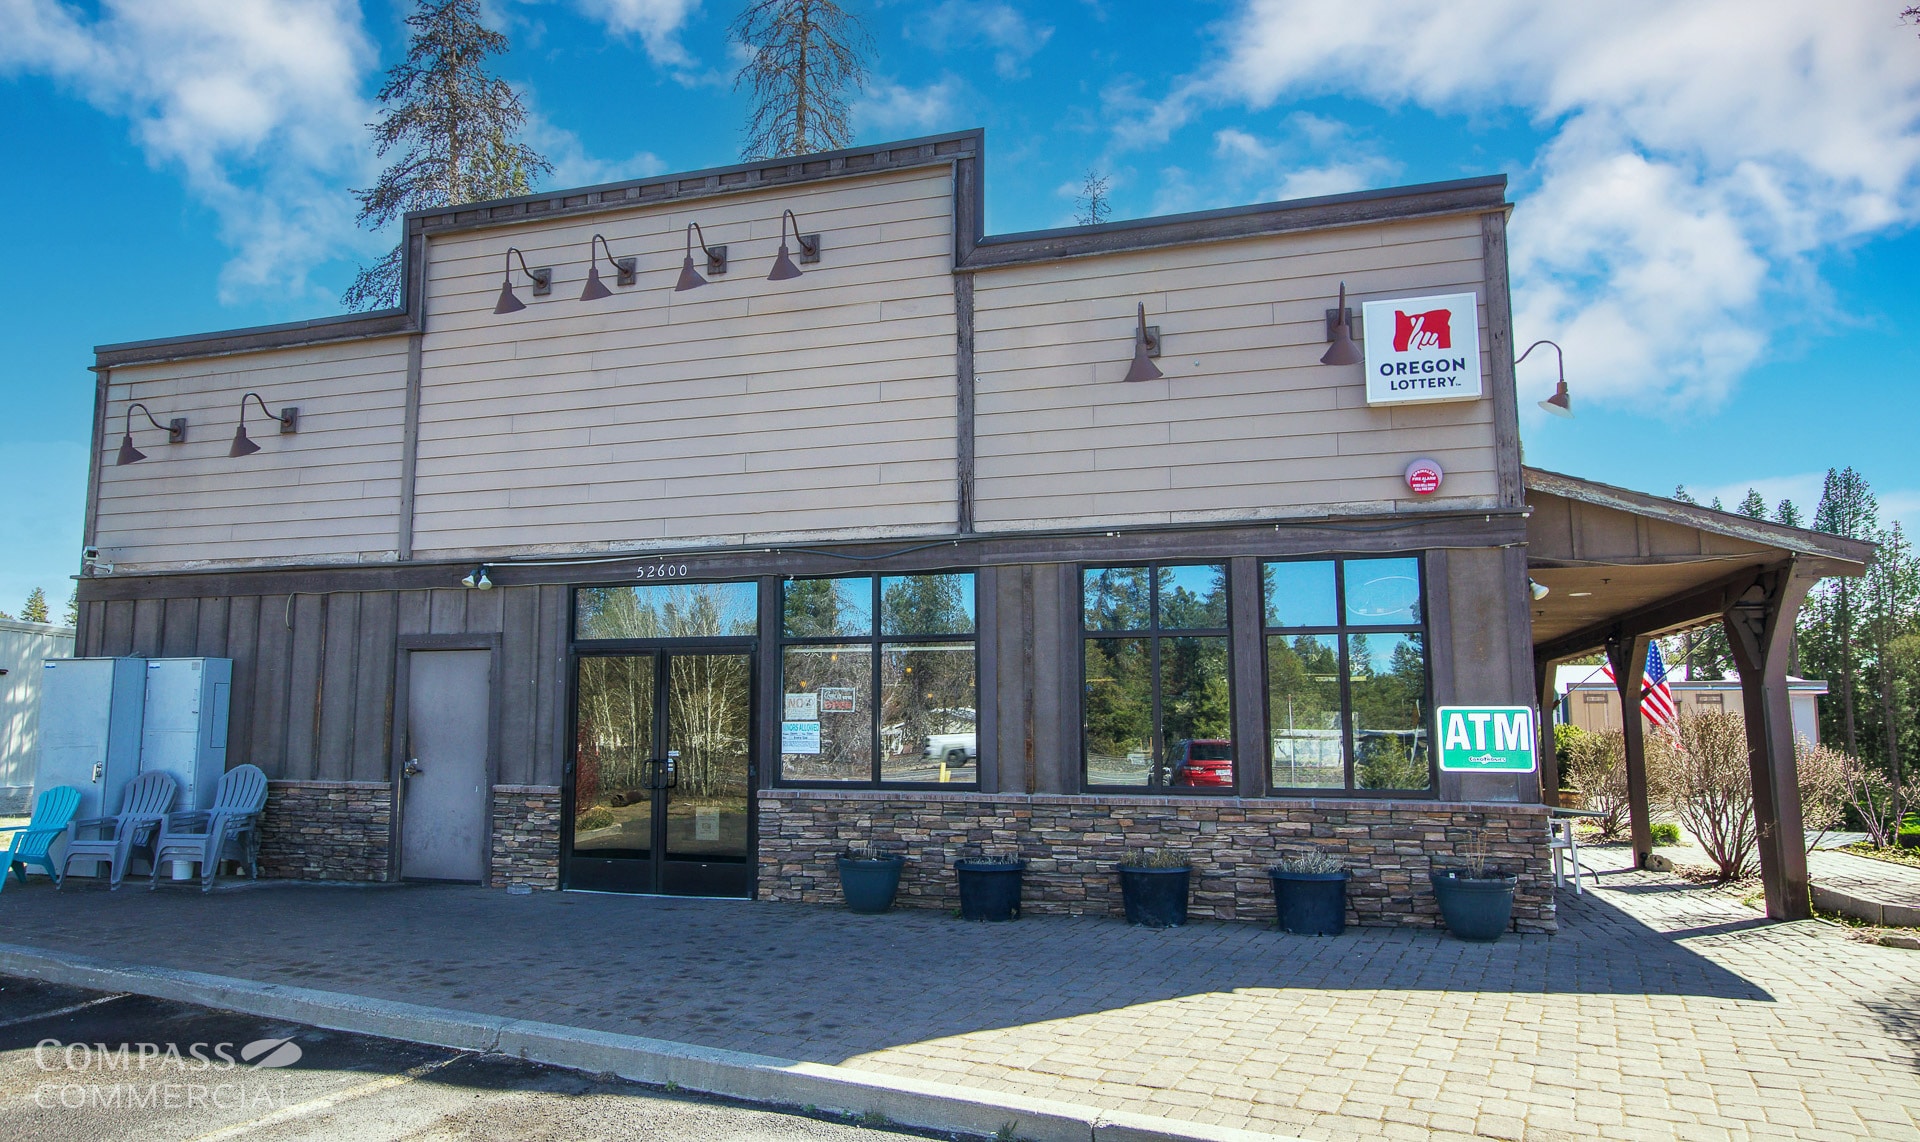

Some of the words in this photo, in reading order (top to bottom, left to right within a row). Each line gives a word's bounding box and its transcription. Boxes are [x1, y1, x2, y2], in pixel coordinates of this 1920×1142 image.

[1380, 358, 1465, 376] OREGON
[1390, 376, 1457, 391] LOTTERY
[636, 564, 688, 579] 52600
[788, 698, 804, 708] NO
[1445, 712, 1530, 751] ATM
